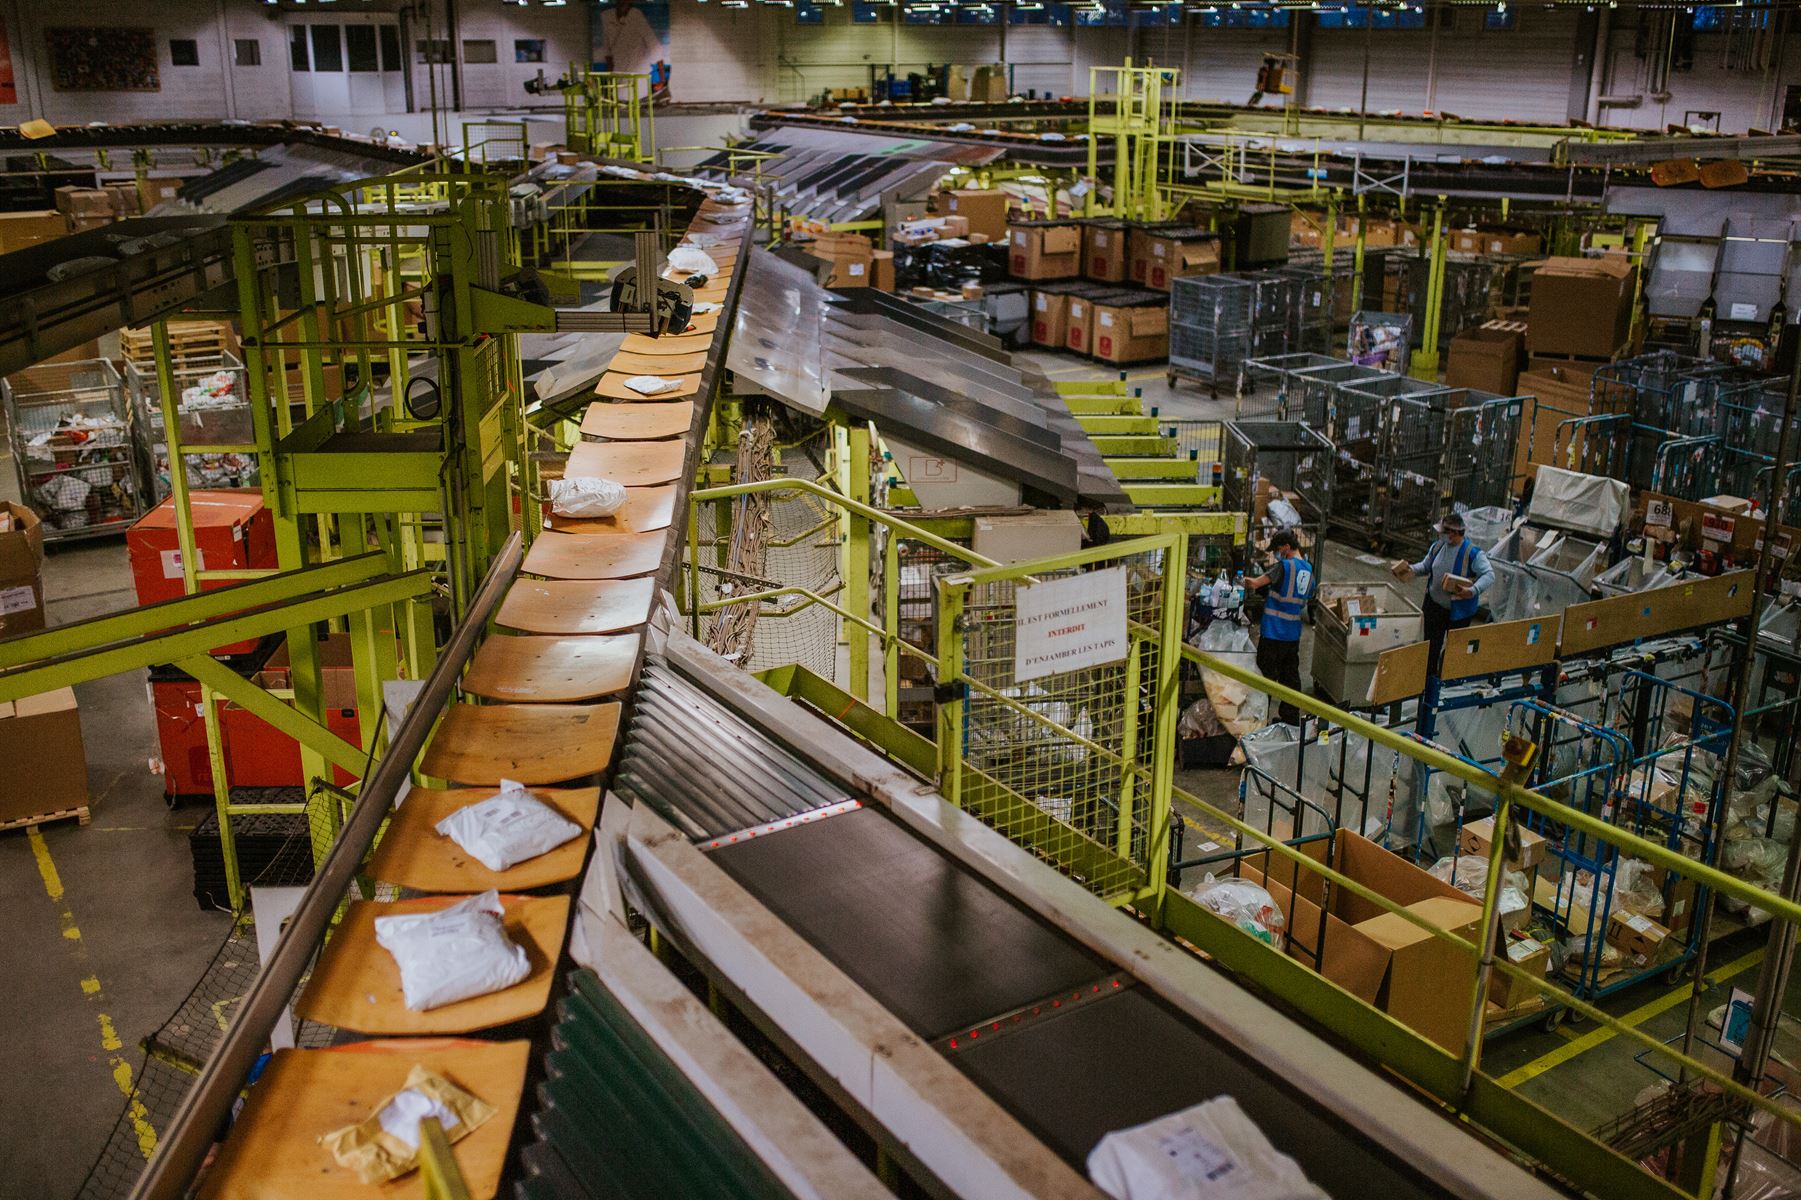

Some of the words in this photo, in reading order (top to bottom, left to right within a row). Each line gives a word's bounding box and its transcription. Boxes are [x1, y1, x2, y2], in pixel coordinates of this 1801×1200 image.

[1017, 618, 1026, 626] IL
[1028, 614, 1042, 624] EST
[1044, 599, 1108, 620] FORMELLEMENT
[1048, 623, 1086, 638] INTERDIT
[1025, 647, 1077, 666] D'ENJAMBER
[1078, 645, 1093, 655] LES
[1094, 639, 1116, 649] TAPIS
